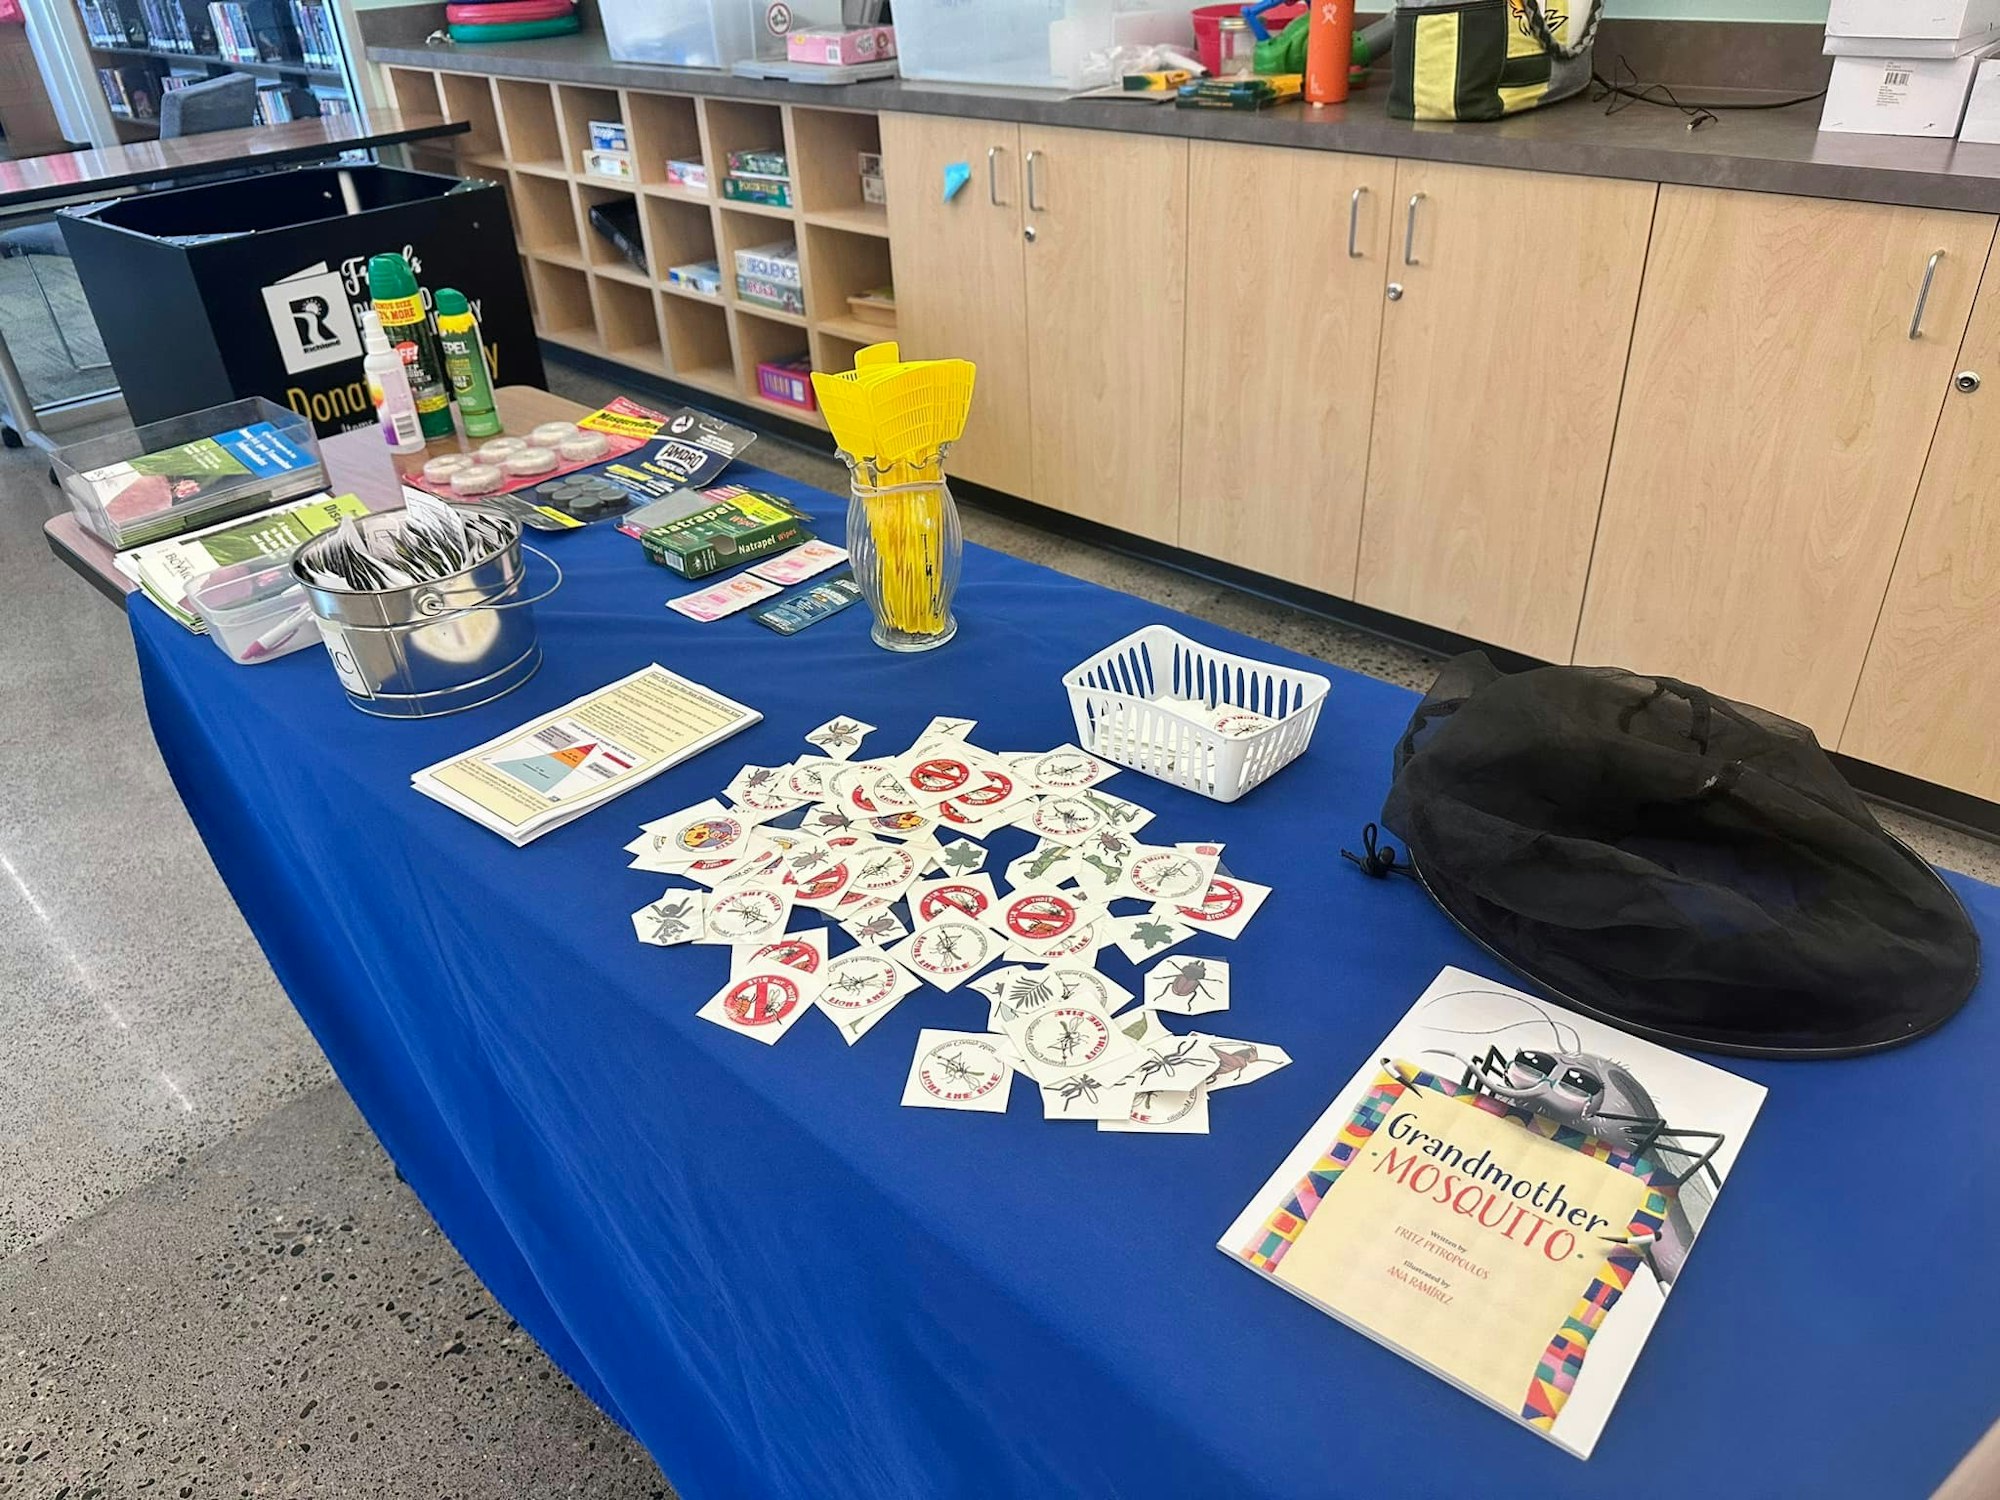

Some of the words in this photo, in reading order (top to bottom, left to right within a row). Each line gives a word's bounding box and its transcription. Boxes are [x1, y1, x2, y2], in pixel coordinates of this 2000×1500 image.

[391, 308, 415, 320] MORE
[660, 444, 703, 469] AMDRO
[652, 503, 736, 537] Natrapel
[738, 535, 776, 555] Natrapel
[777, 528, 798, 542] Wipes
[1387, 1112, 1609, 1233] Grandmother
[1373, 1147, 1576, 1262] MOSQUITO
[1394, 1226, 1424, 1246] FRITZ
[1423, 1240, 1490, 1280] PETROPOULOS
[1430, 1230, 1457, 1249] Written
[1457, 1244, 1468, 1254] by
[1387, 1266, 1408, 1282] ANA
[1403, 1260, 1441, 1284] Illustrated
[1440, 1279, 1451, 1289] by
